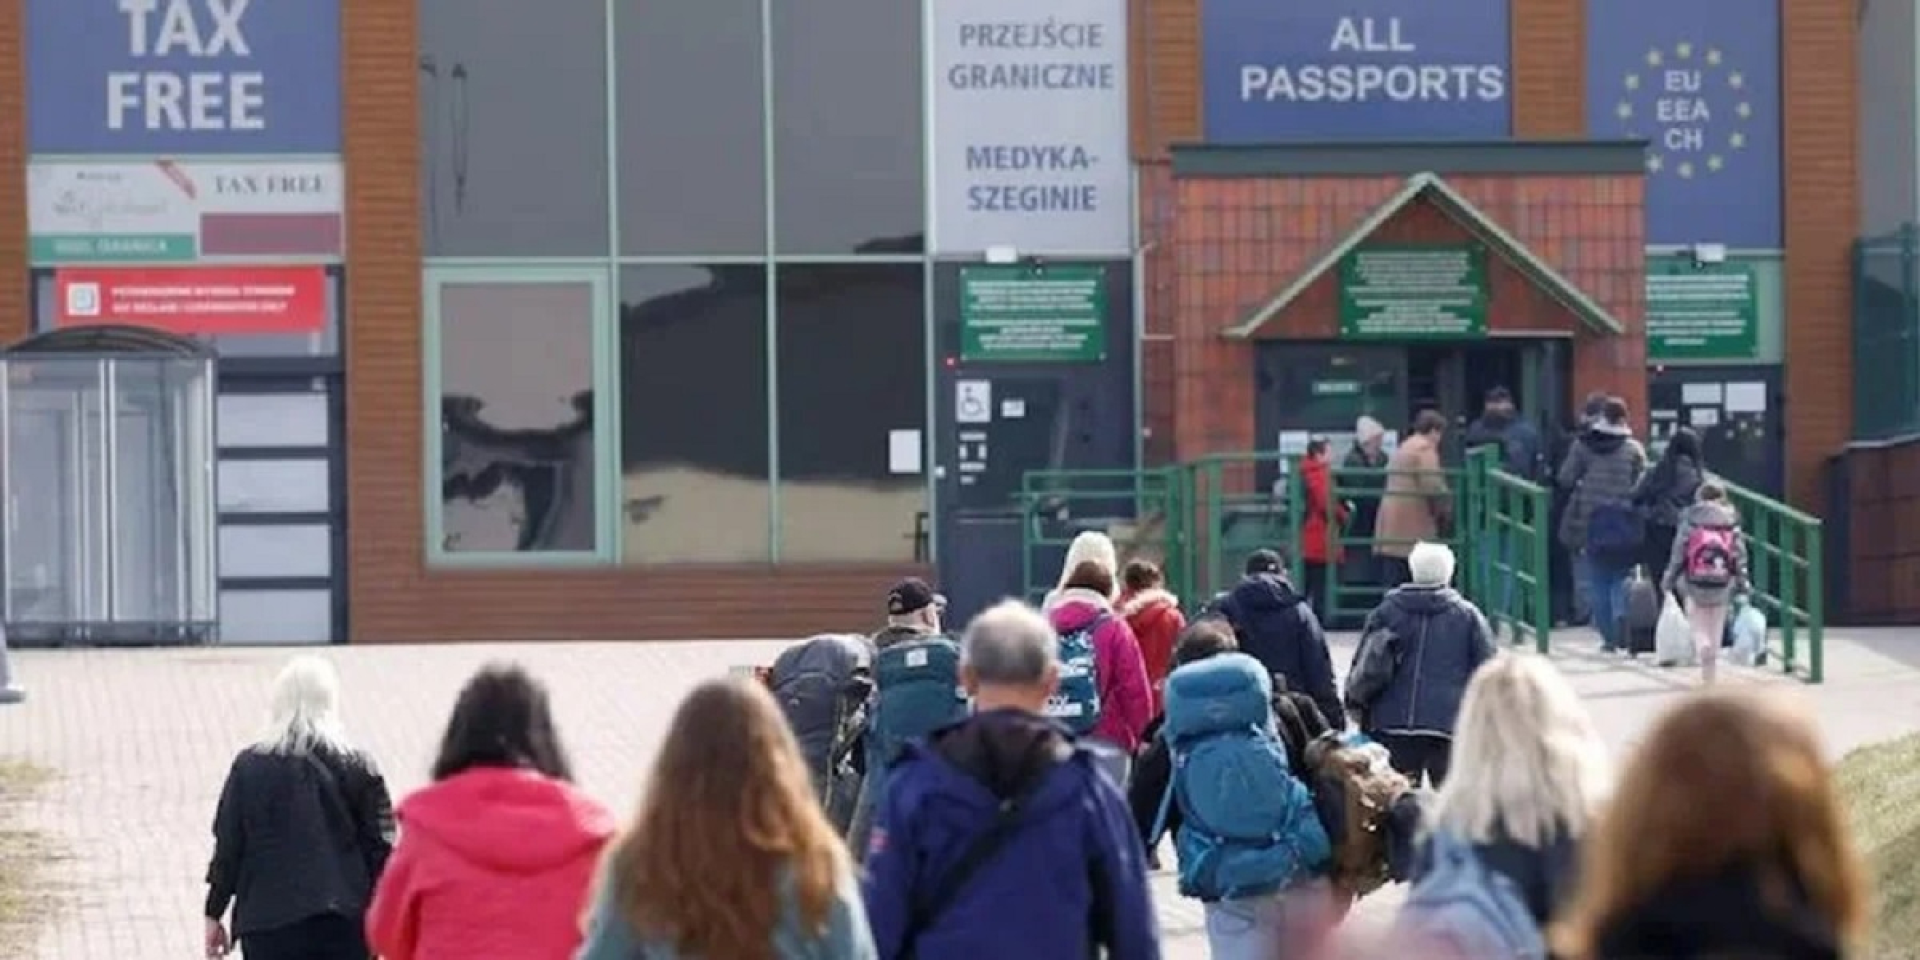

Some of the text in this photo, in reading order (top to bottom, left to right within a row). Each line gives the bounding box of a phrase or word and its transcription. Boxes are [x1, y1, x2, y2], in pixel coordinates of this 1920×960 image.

[119, 0, 251, 56] TAX
[959, 15, 1104, 48] PRZEJŚCIE
[1330, 17, 1416, 51] ALL
[948, 63, 1114, 89] GRANICZNE
[1240, 64, 1505, 100] PASSPORTS
[1664, 69, 1701, 92] EU
[106, 71, 266, 129] FREE
[1656, 98, 1710, 122] EEA
[1664, 127, 1703, 151] CH
[966, 145, 1099, 170] MEDYKA-
[215, 174, 257, 193] TAX
[267, 174, 323, 193] FREE
[968, 185, 1097, 211] SZEGINIE
